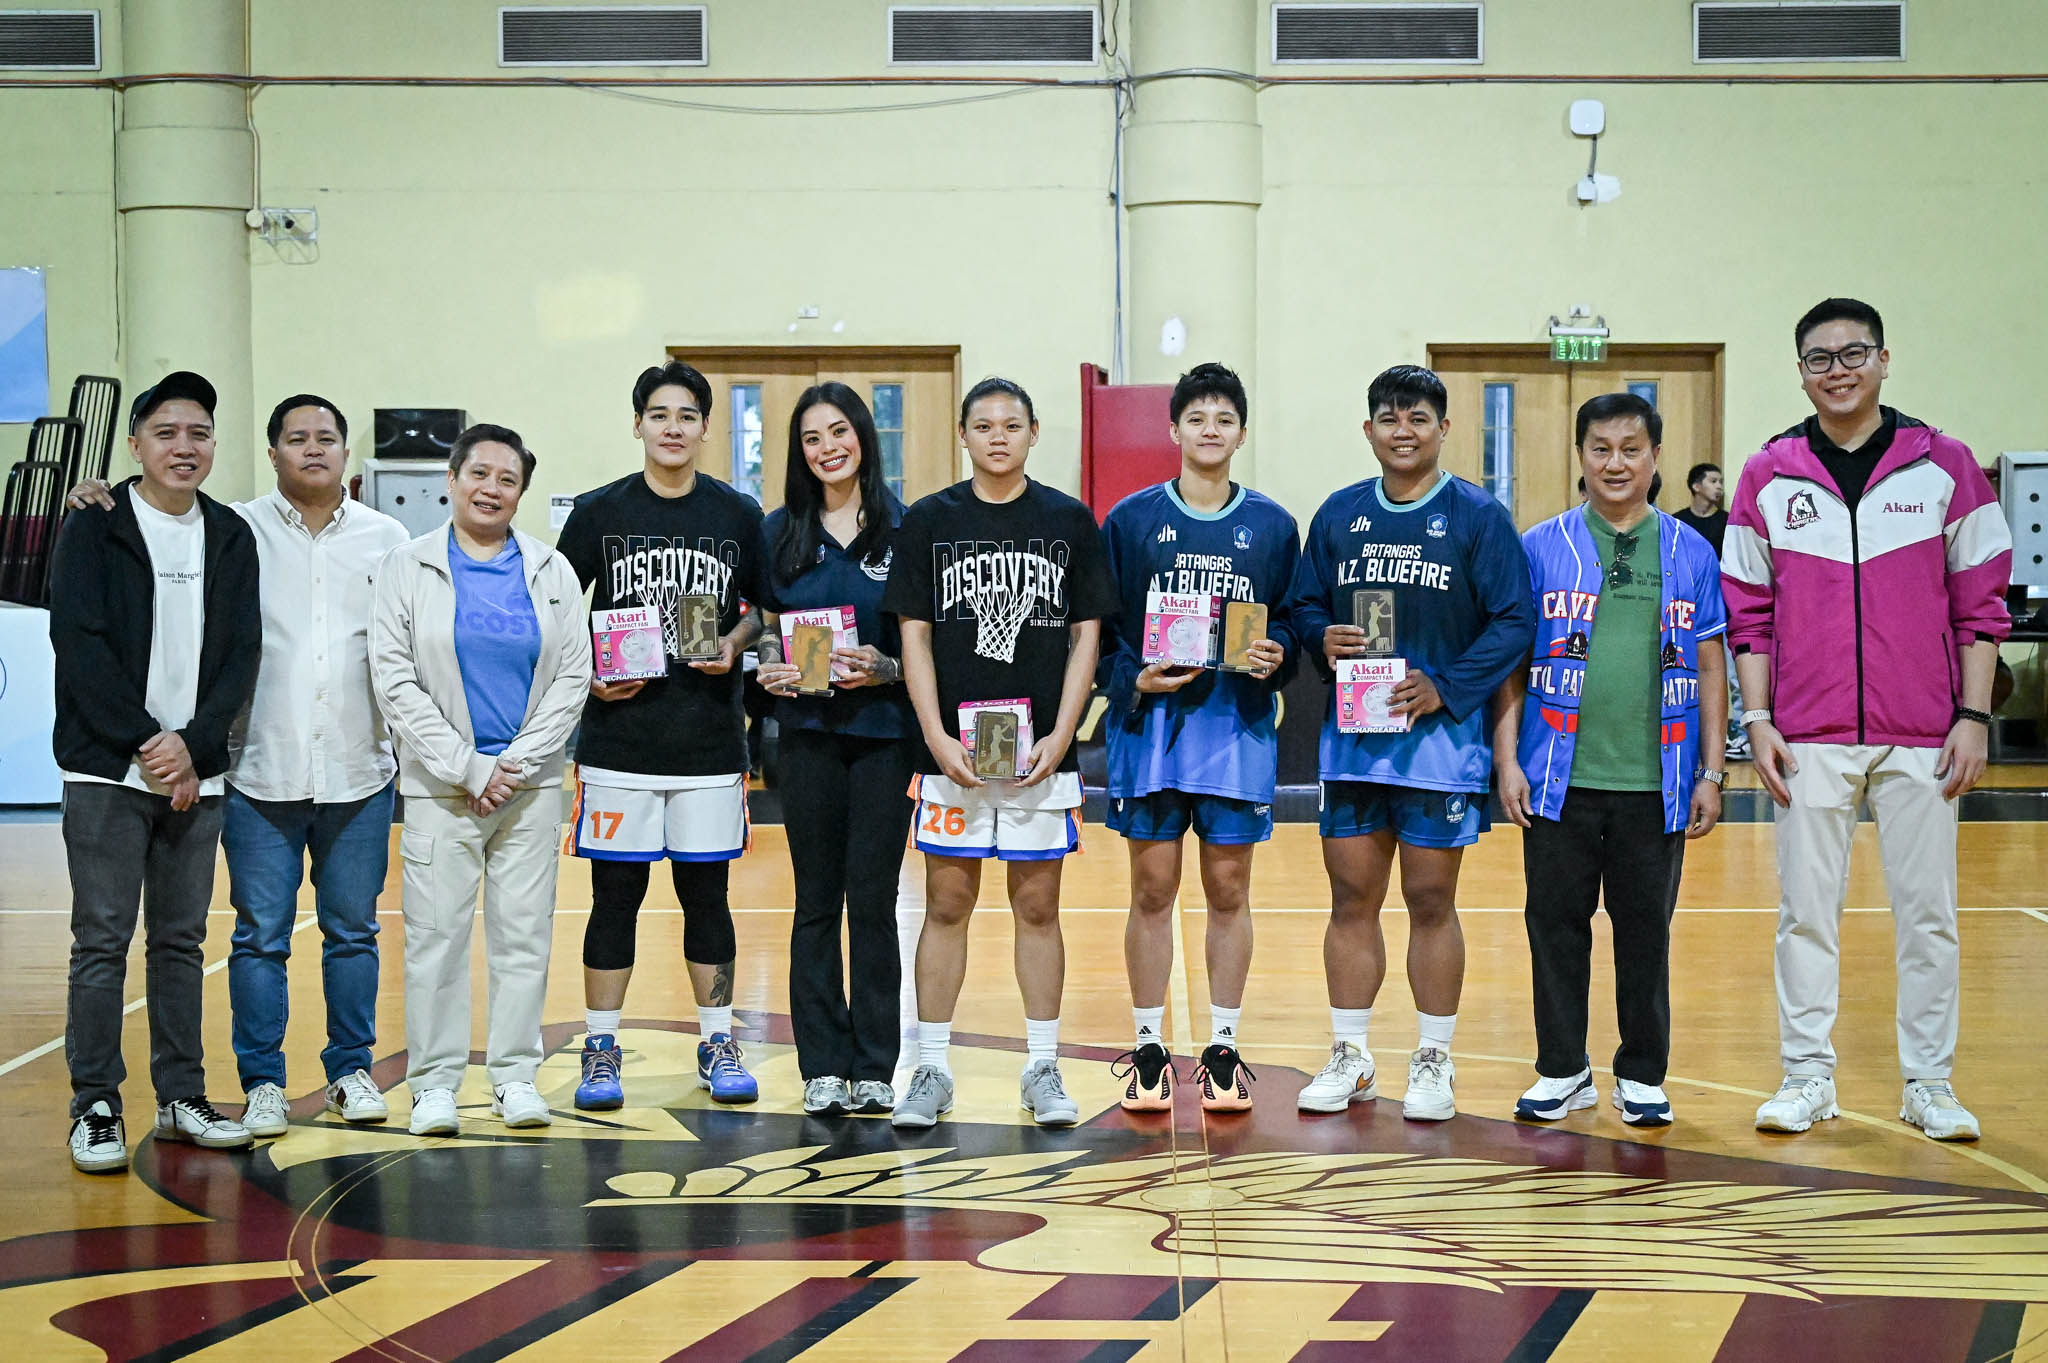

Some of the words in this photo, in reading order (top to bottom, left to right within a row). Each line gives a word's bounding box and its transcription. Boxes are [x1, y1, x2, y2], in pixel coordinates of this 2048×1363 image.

[1556, 337, 1601, 360] EXIT
[1883, 502, 1924, 513] Akari
[1361, 543, 1422, 559] BATANGAS
[612, 548, 732, 607] DISCOVERY
[942, 552, 1065, 611] DISCOVERY
[1338, 559, 1360, 587] N.Z.
[1365, 558, 1452, 591] BLUEFIRE
[1160, 594, 1198, 608] Akari
[606, 610, 647, 624] Akari
[794, 613, 830, 625] Akari
[1030, 619, 1048, 627] SINCE
[1144, 657, 1202, 667] RECGEABLE
[1351, 662, 1392, 675] Akari
[601, 672, 663, 682] RECHARGEABLE
[590, 811, 624, 840] 17
[922, 803, 966, 836] 26
